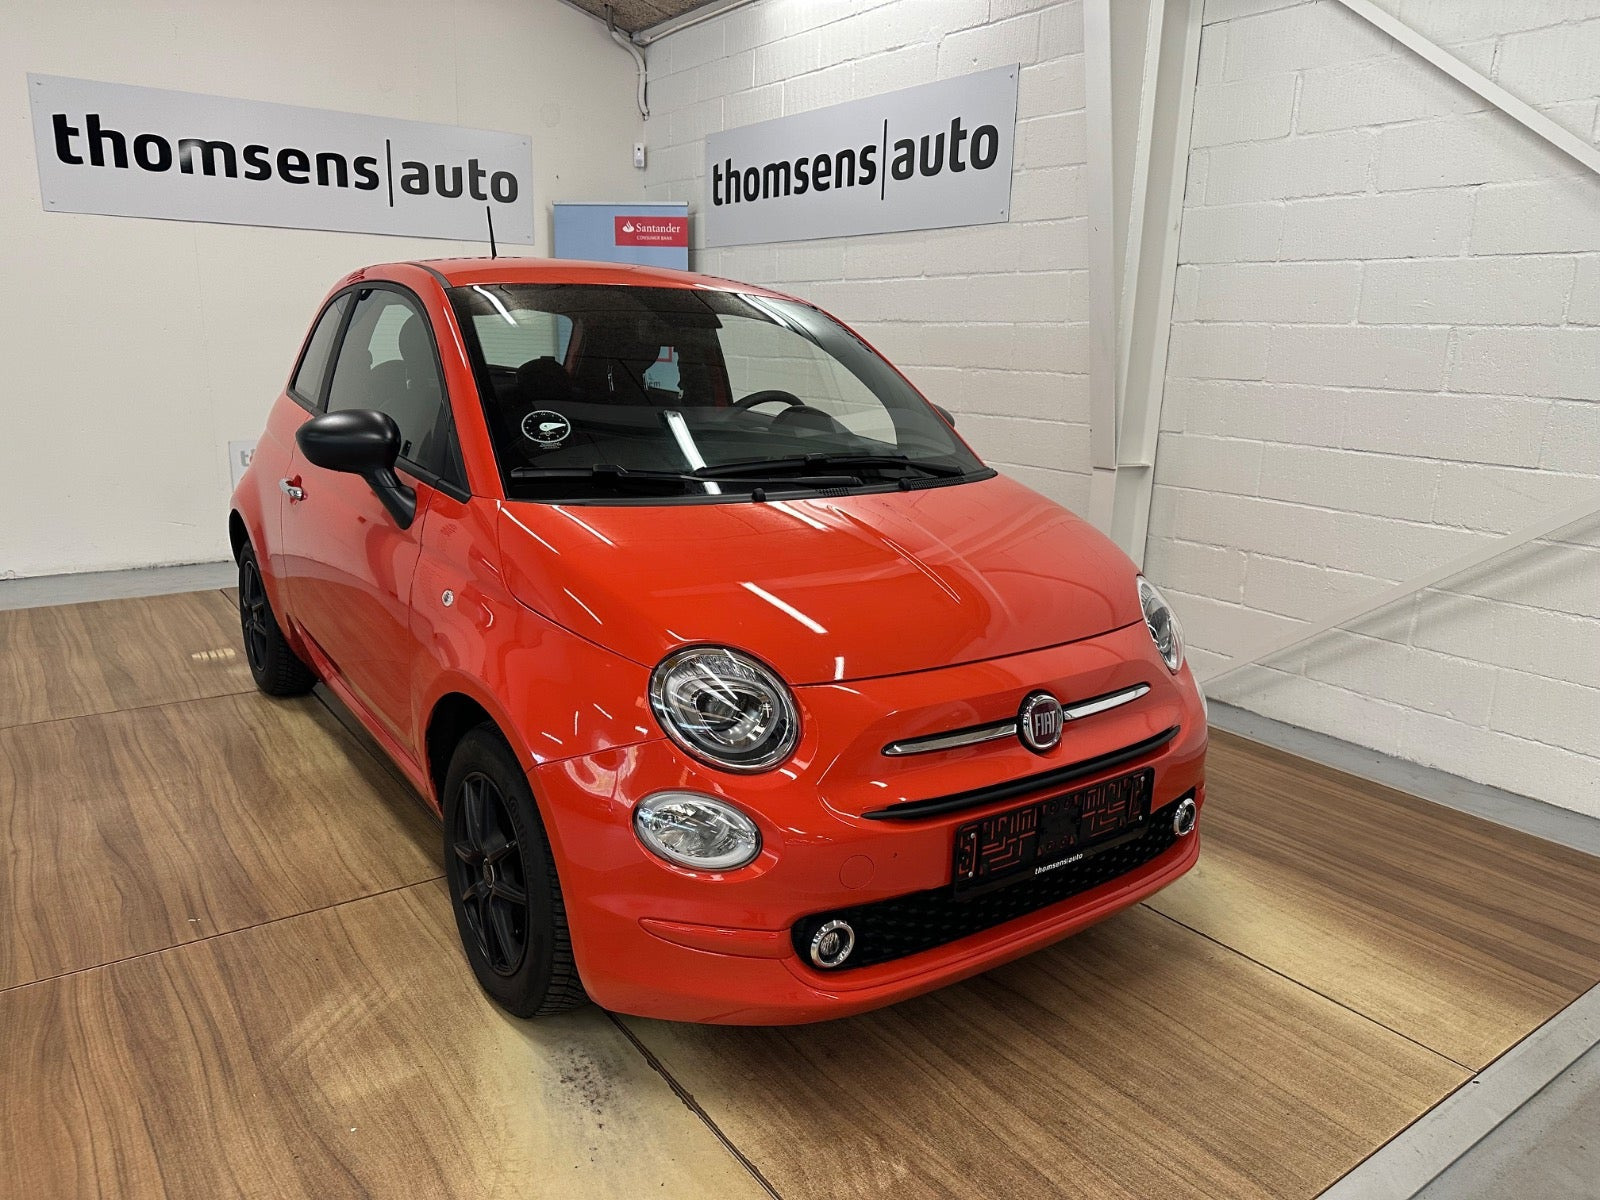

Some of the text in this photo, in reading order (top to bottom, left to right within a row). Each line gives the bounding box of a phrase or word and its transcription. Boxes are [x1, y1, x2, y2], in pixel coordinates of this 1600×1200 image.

[52, 113, 519, 204] thomsens auto
[712, 116, 999, 207] thomsens auto
[636, 222, 681, 233] Santander
[1034, 710, 1056, 737] FIAT
